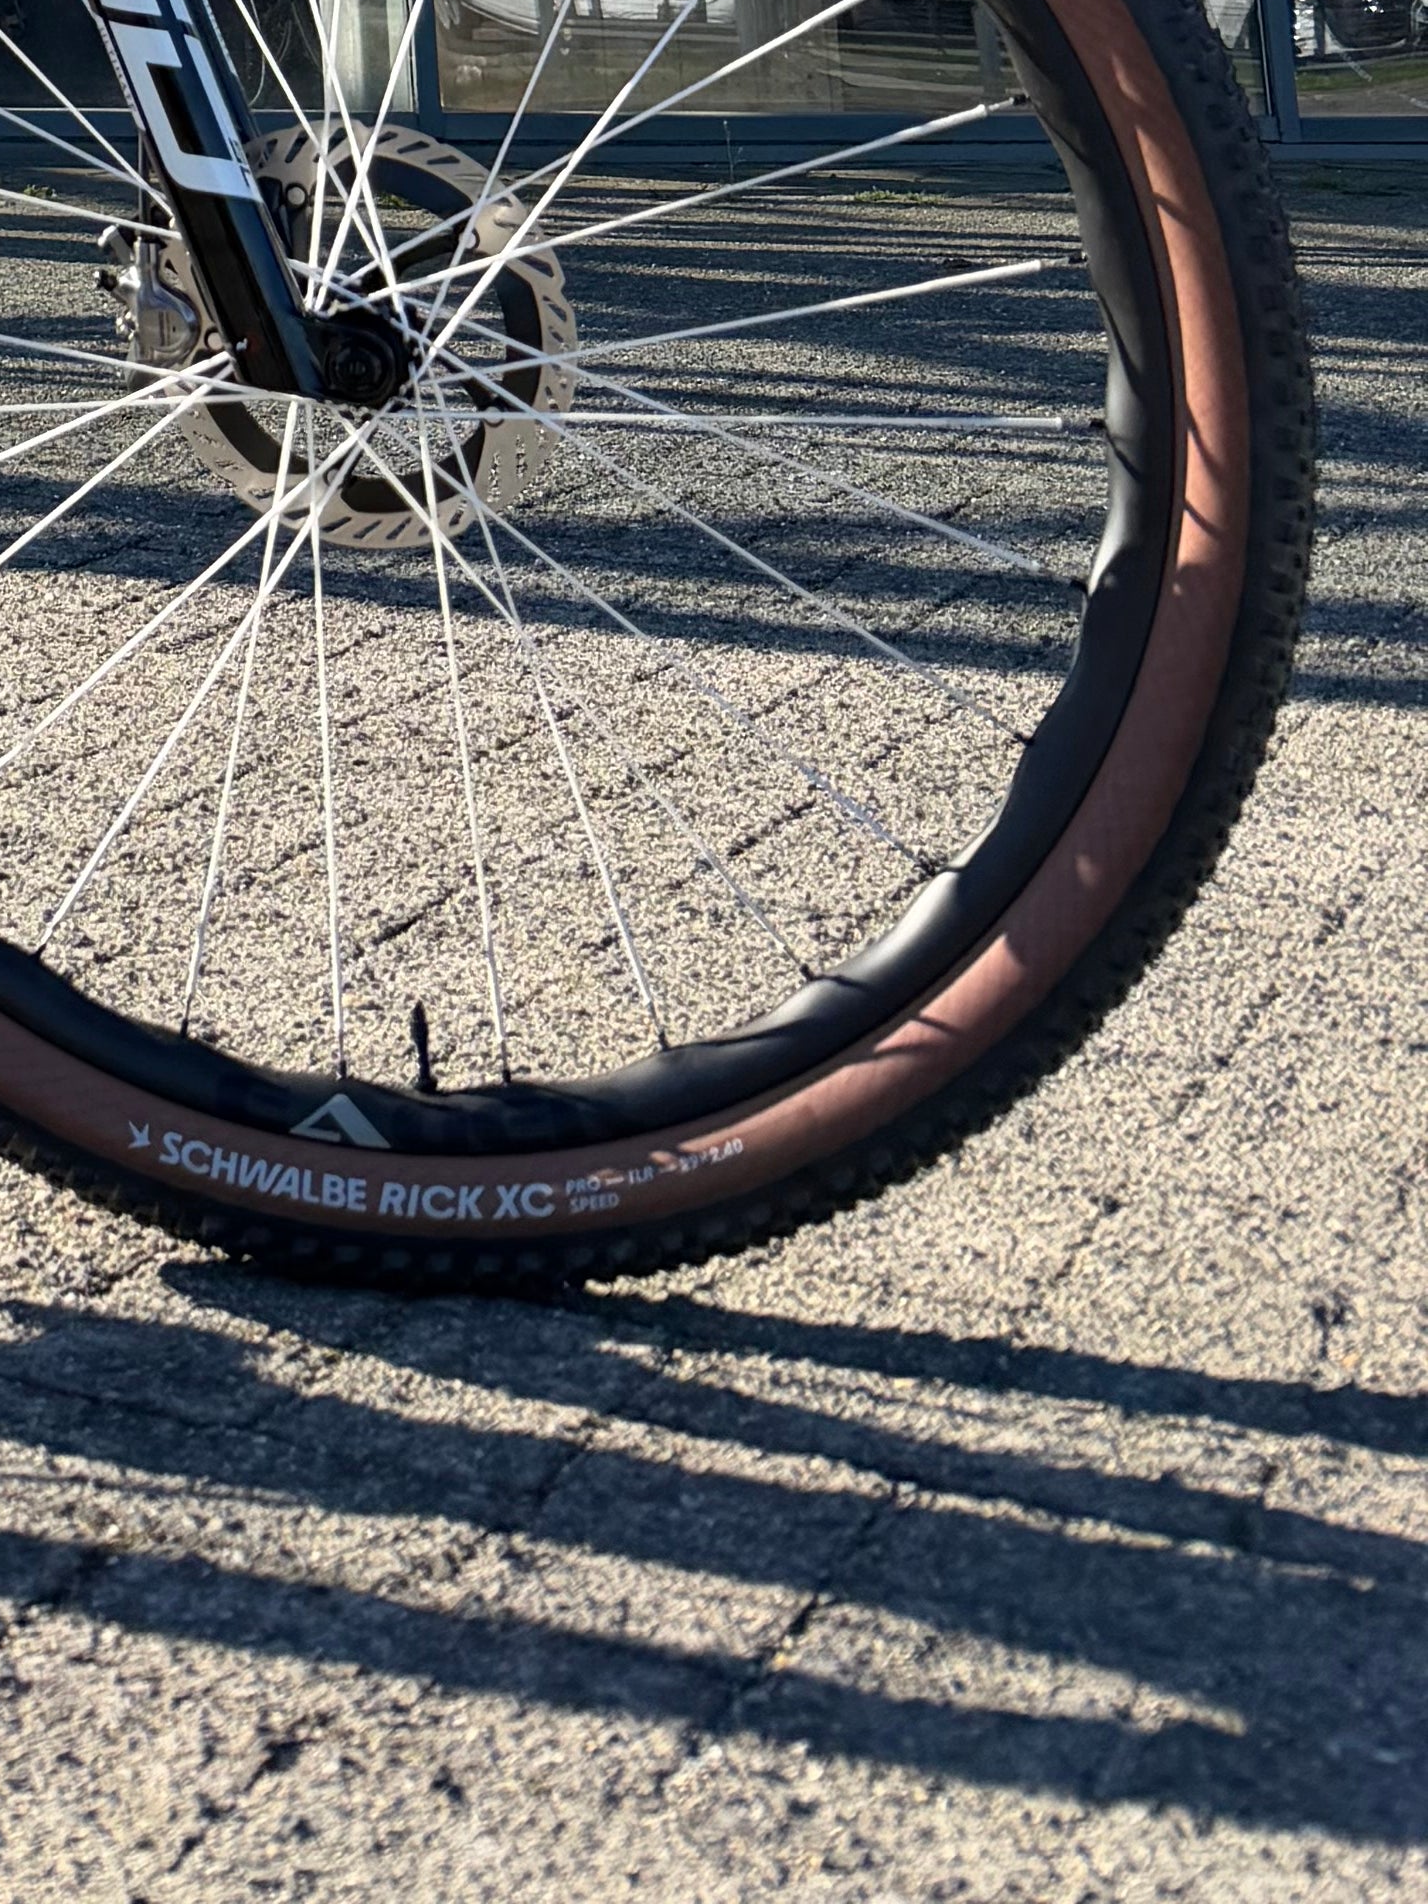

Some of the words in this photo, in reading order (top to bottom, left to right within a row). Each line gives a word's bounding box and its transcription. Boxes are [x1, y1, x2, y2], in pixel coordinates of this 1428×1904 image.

[159, 1130, 367, 1212] SCHWALBE
[378, 1180, 484, 1221] RICK
[491, 1181, 556, 1221] XC
[565, 1175, 601, 1195] PRO
[569, 1192, 621, 1214] SPEED
